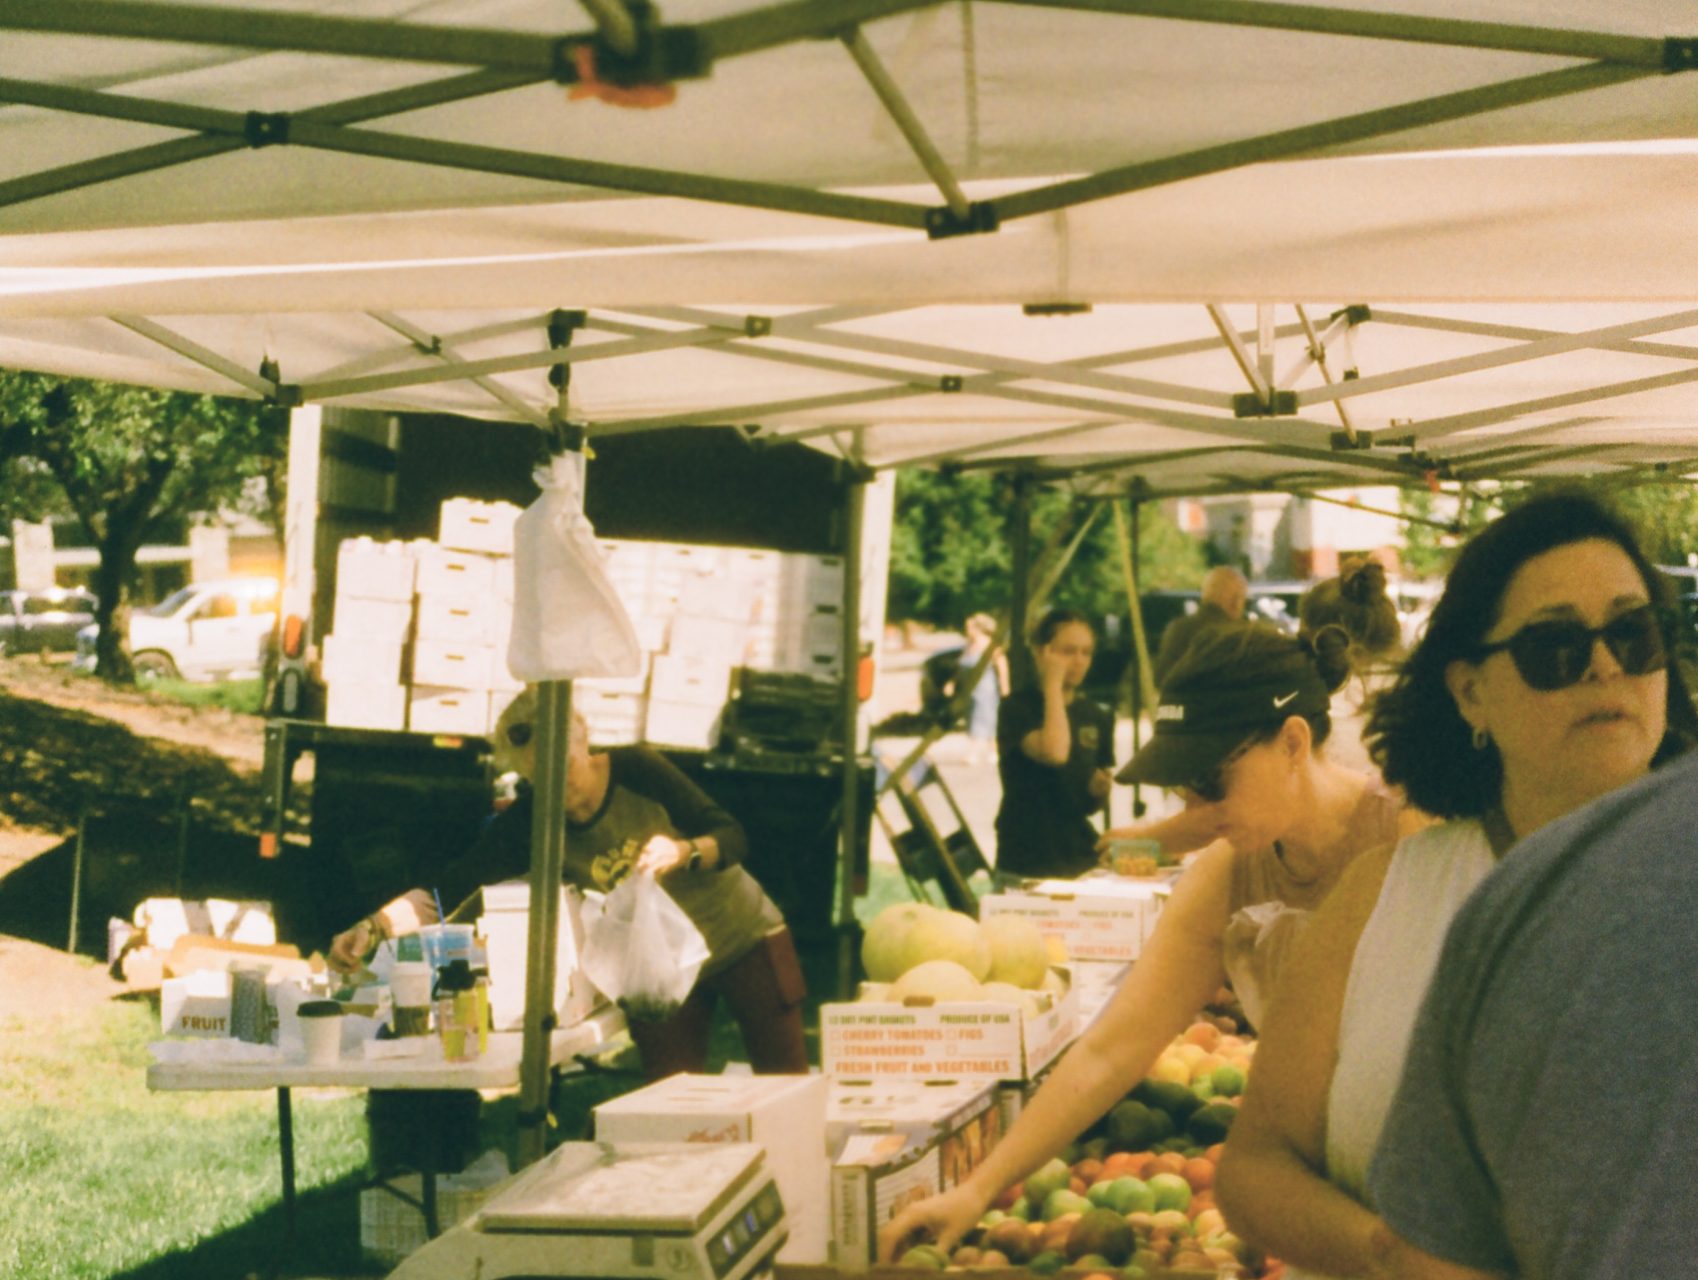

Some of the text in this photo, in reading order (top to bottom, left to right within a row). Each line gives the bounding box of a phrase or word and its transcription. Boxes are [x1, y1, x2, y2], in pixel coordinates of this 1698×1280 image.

[182, 1015, 227, 1031] FRUIT
[940, 1014, 1011, 1024] PRODUCE OF USA
[842, 1028, 943, 1040] CHERRY TOMATOES
[958, 1028, 984, 1040] FIGS
[844, 1044, 925, 1056] STRAWBERRIES
[835, 1060, 1010, 1073] FRESH FRUIT AND VEGETABLES
